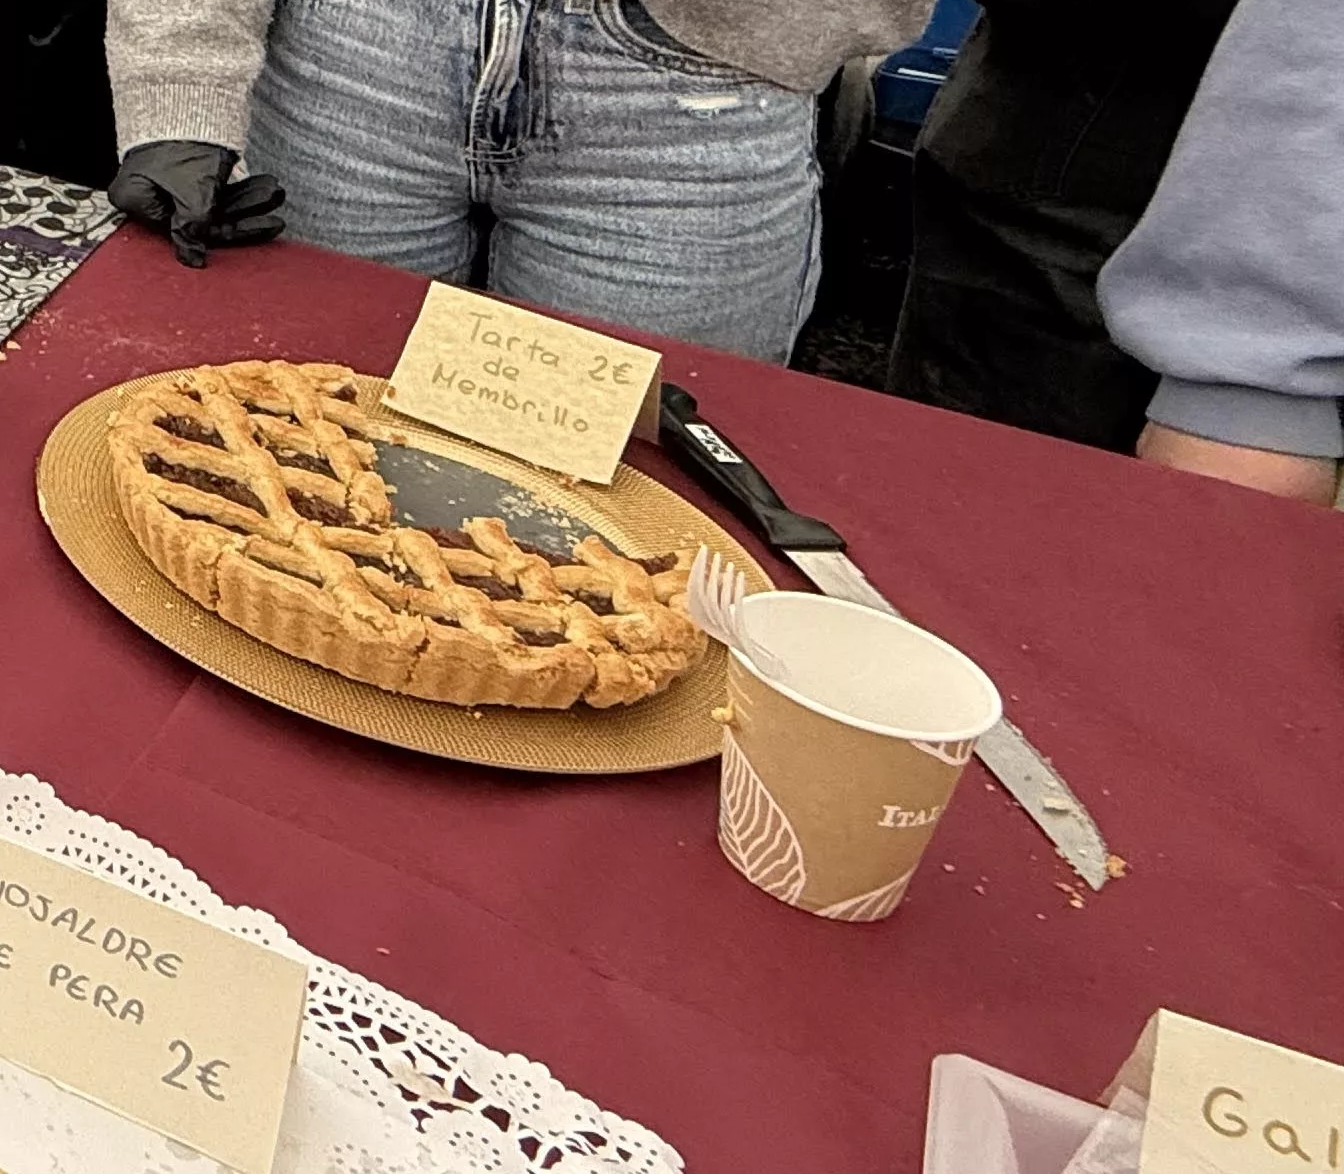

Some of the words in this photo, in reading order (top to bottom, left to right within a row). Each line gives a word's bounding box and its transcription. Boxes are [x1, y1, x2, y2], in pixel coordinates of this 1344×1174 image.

[468, 311, 560, 367] Tarta
[588, 355, 634, 385] 2€
[482, 357, 520, 382] de
[431, 362, 590, 432] Membrillo
[49, 964, 145, 1025] PERA
[161, 1039, 231, 1102] 2€
